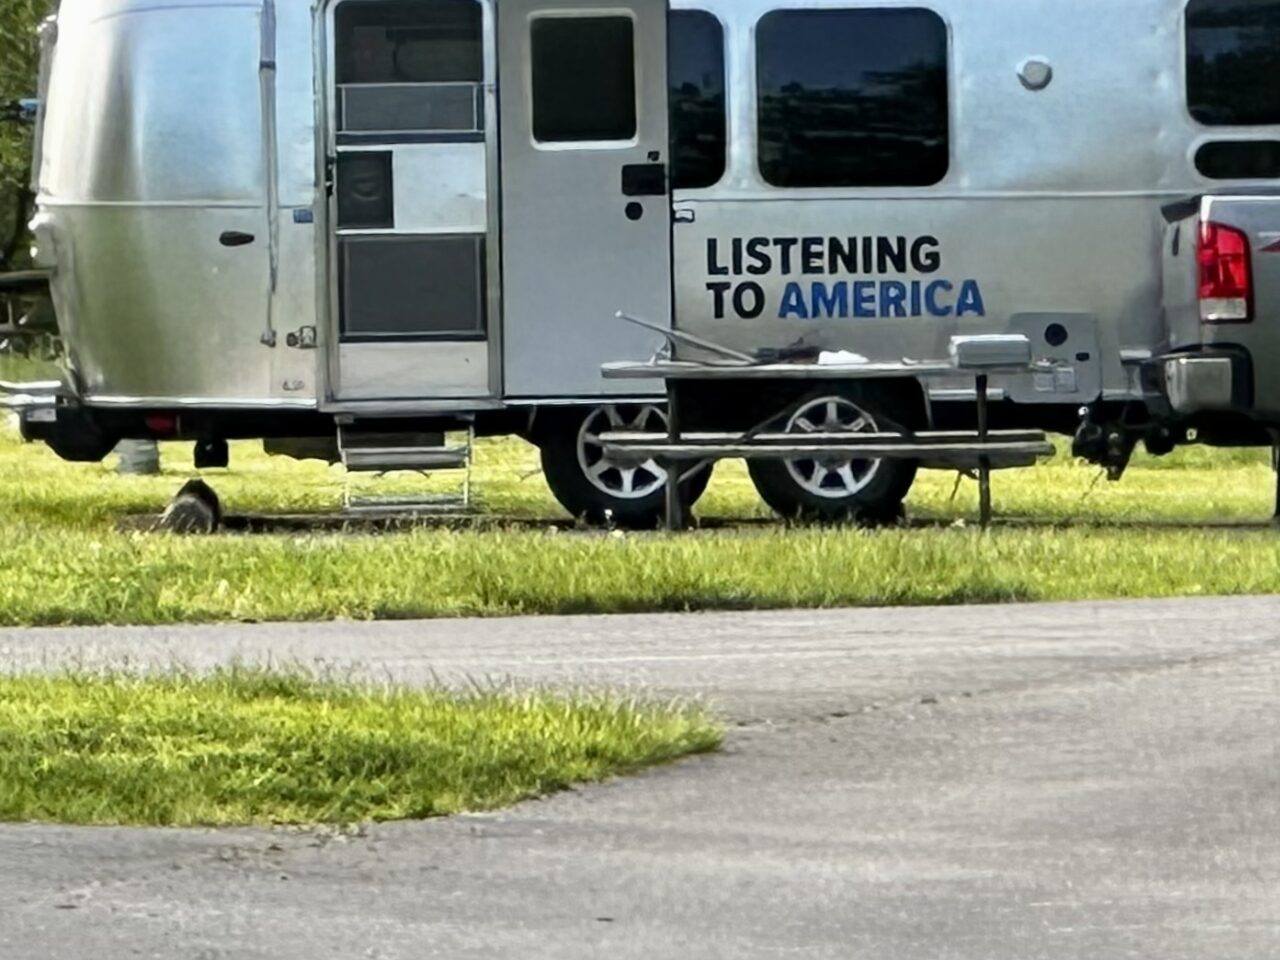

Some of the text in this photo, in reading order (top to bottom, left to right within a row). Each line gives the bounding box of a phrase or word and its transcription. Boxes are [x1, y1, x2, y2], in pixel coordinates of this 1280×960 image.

[706, 234, 941, 275] LISTENING
[706, 279, 986, 319] TO AMERICA
